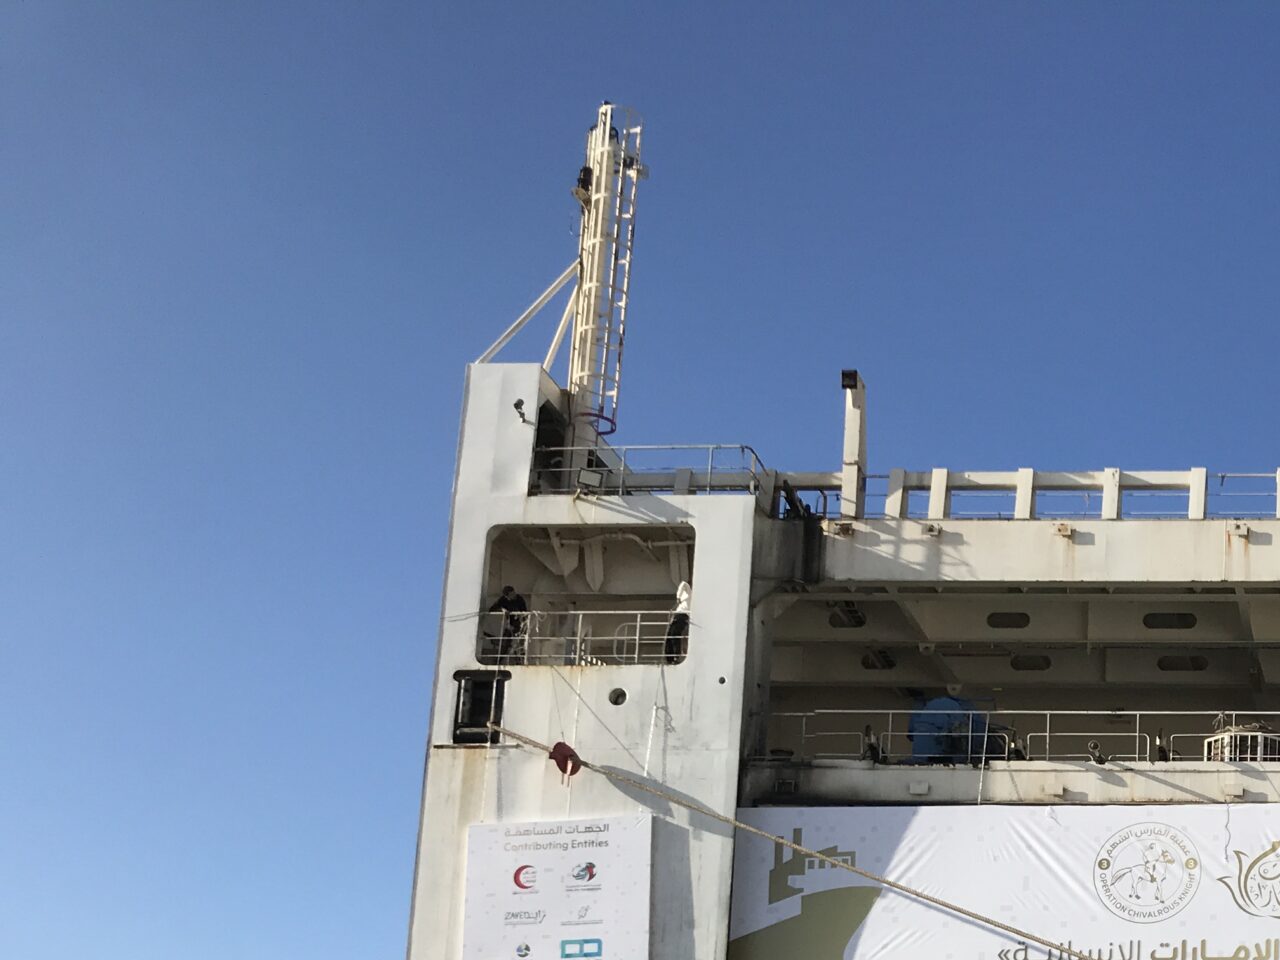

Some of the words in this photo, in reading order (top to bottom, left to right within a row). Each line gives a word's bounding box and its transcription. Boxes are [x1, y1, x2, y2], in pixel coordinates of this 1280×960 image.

[504, 840, 569, 852] Contributing
[571, 839, 609, 849] Entities
[1099, 872, 1127, 913] OPERATION
[1127, 899, 1181, 919] CHIVALROUS
[1178, 872, 1196, 903] KNIGHT
